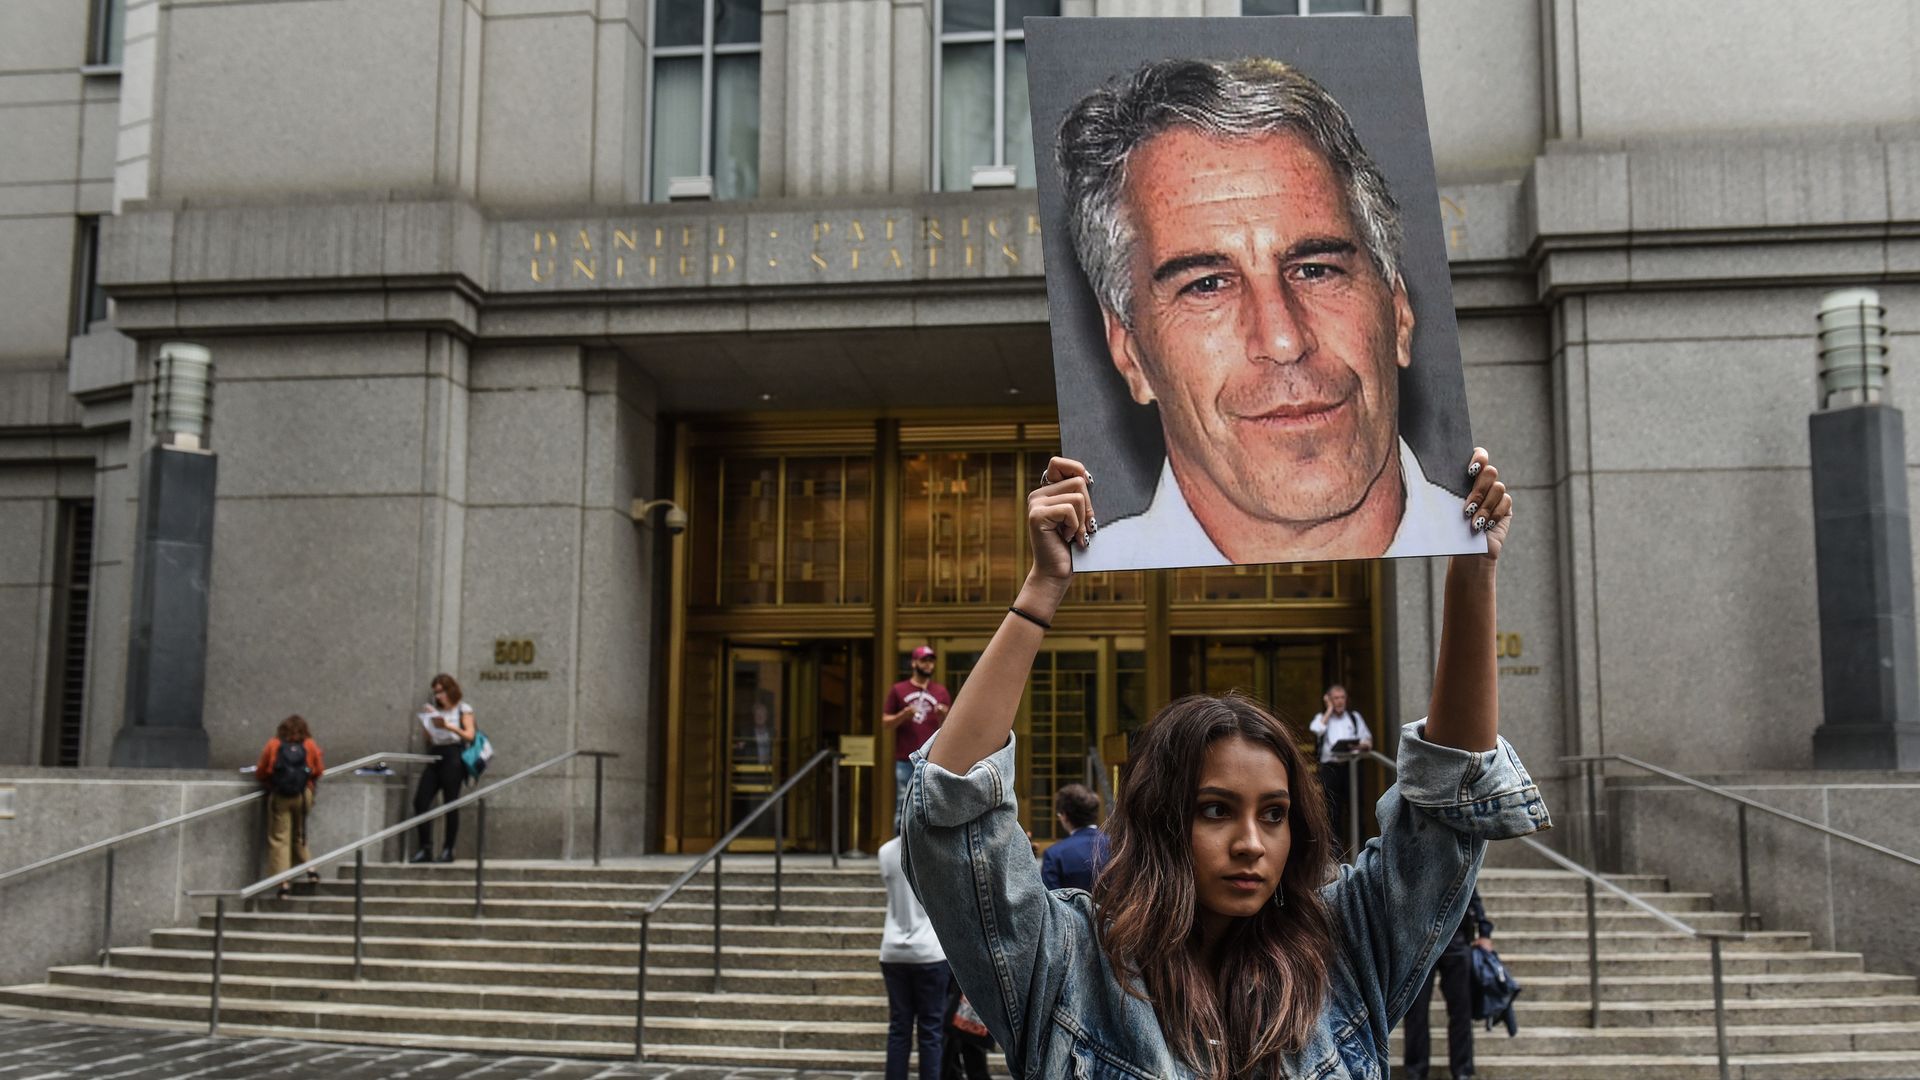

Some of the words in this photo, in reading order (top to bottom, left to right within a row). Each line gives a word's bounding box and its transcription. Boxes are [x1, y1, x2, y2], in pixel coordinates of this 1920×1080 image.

[533, 225, 729, 251] DANIEL
[530, 253, 735, 282] UNITED
[811, 244, 1019, 270] STATES
[495, 640, 535, 664] 500
